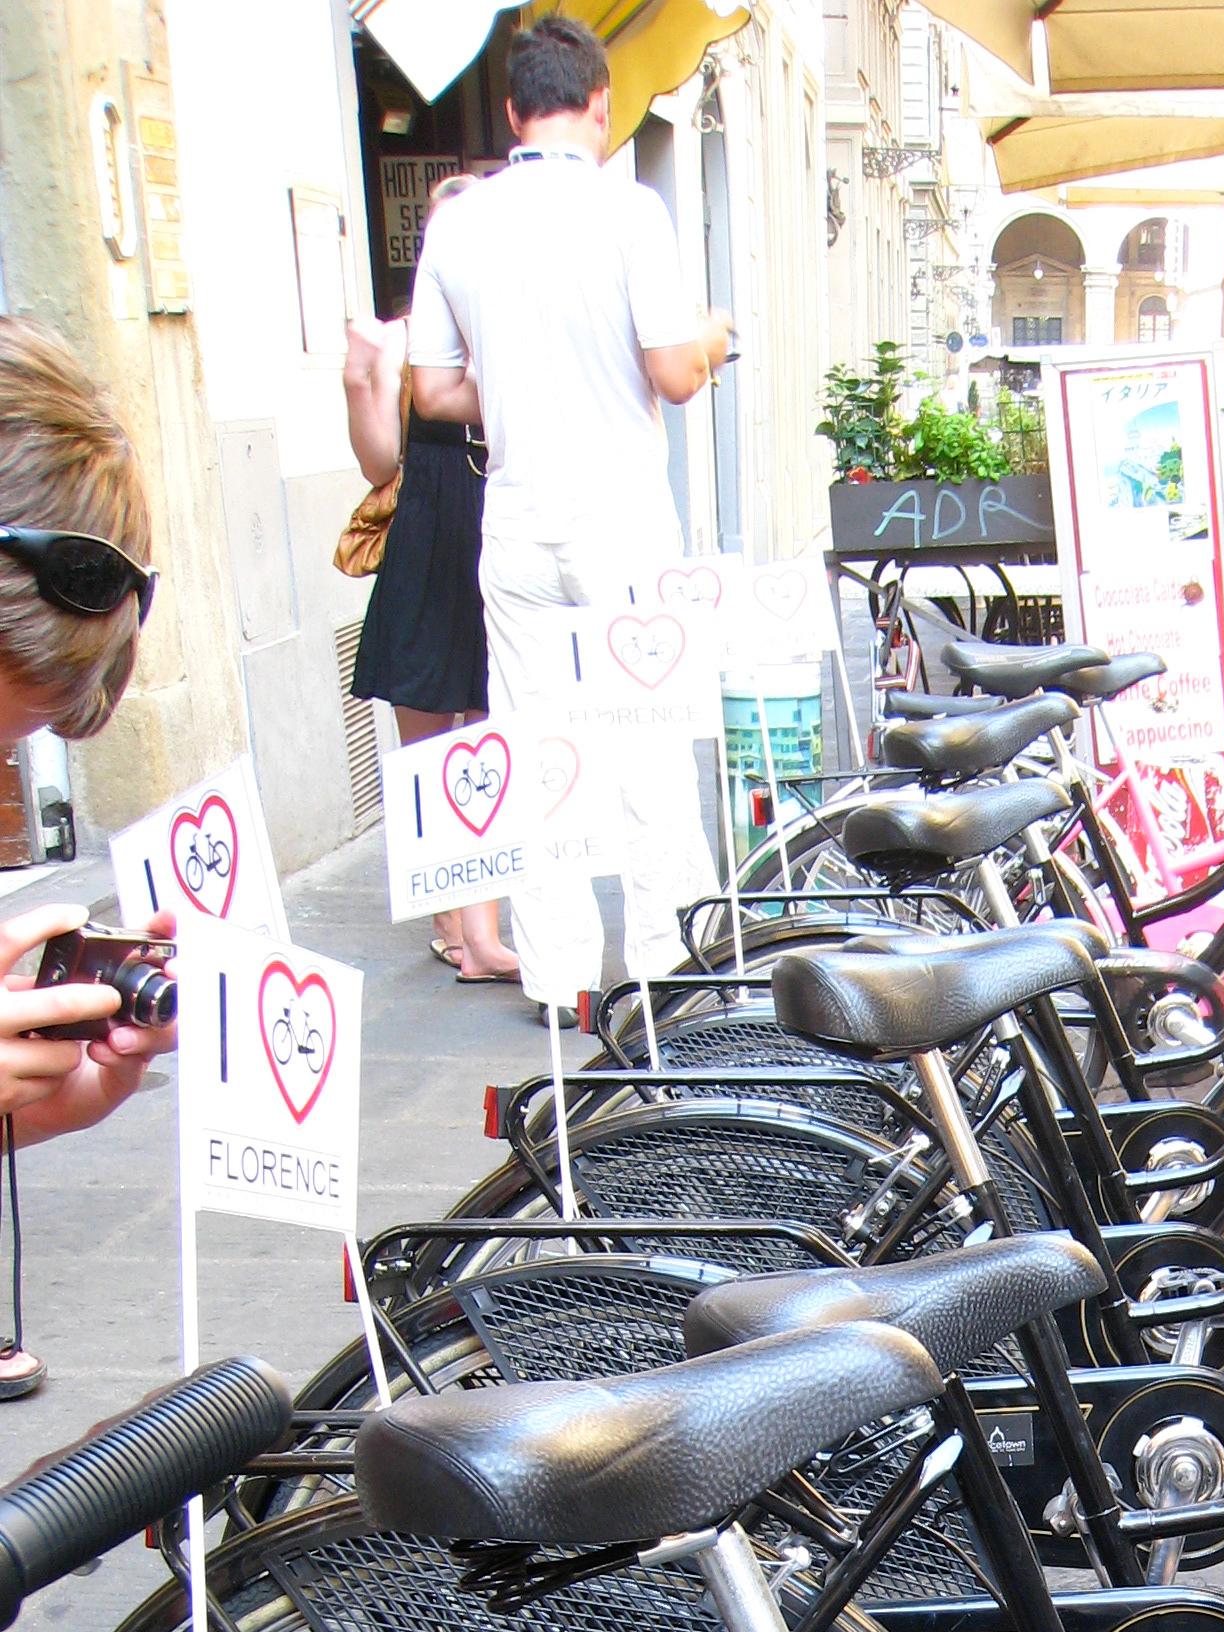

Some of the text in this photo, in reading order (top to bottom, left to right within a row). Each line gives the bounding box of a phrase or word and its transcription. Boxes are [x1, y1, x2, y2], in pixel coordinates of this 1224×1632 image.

[1101, 382, 1168, 404] イタリア
[571, 631, 582, 683] I
[1158, 673, 1212, 699] Coffee
[1120, 718, 1214, 750] appuccino
[413, 773, 424, 839] I
[410, 846, 525, 897] FLORENCE
[218, 972, 229, 1084] I
[209, 1138, 340, 1199] FLORENCE
